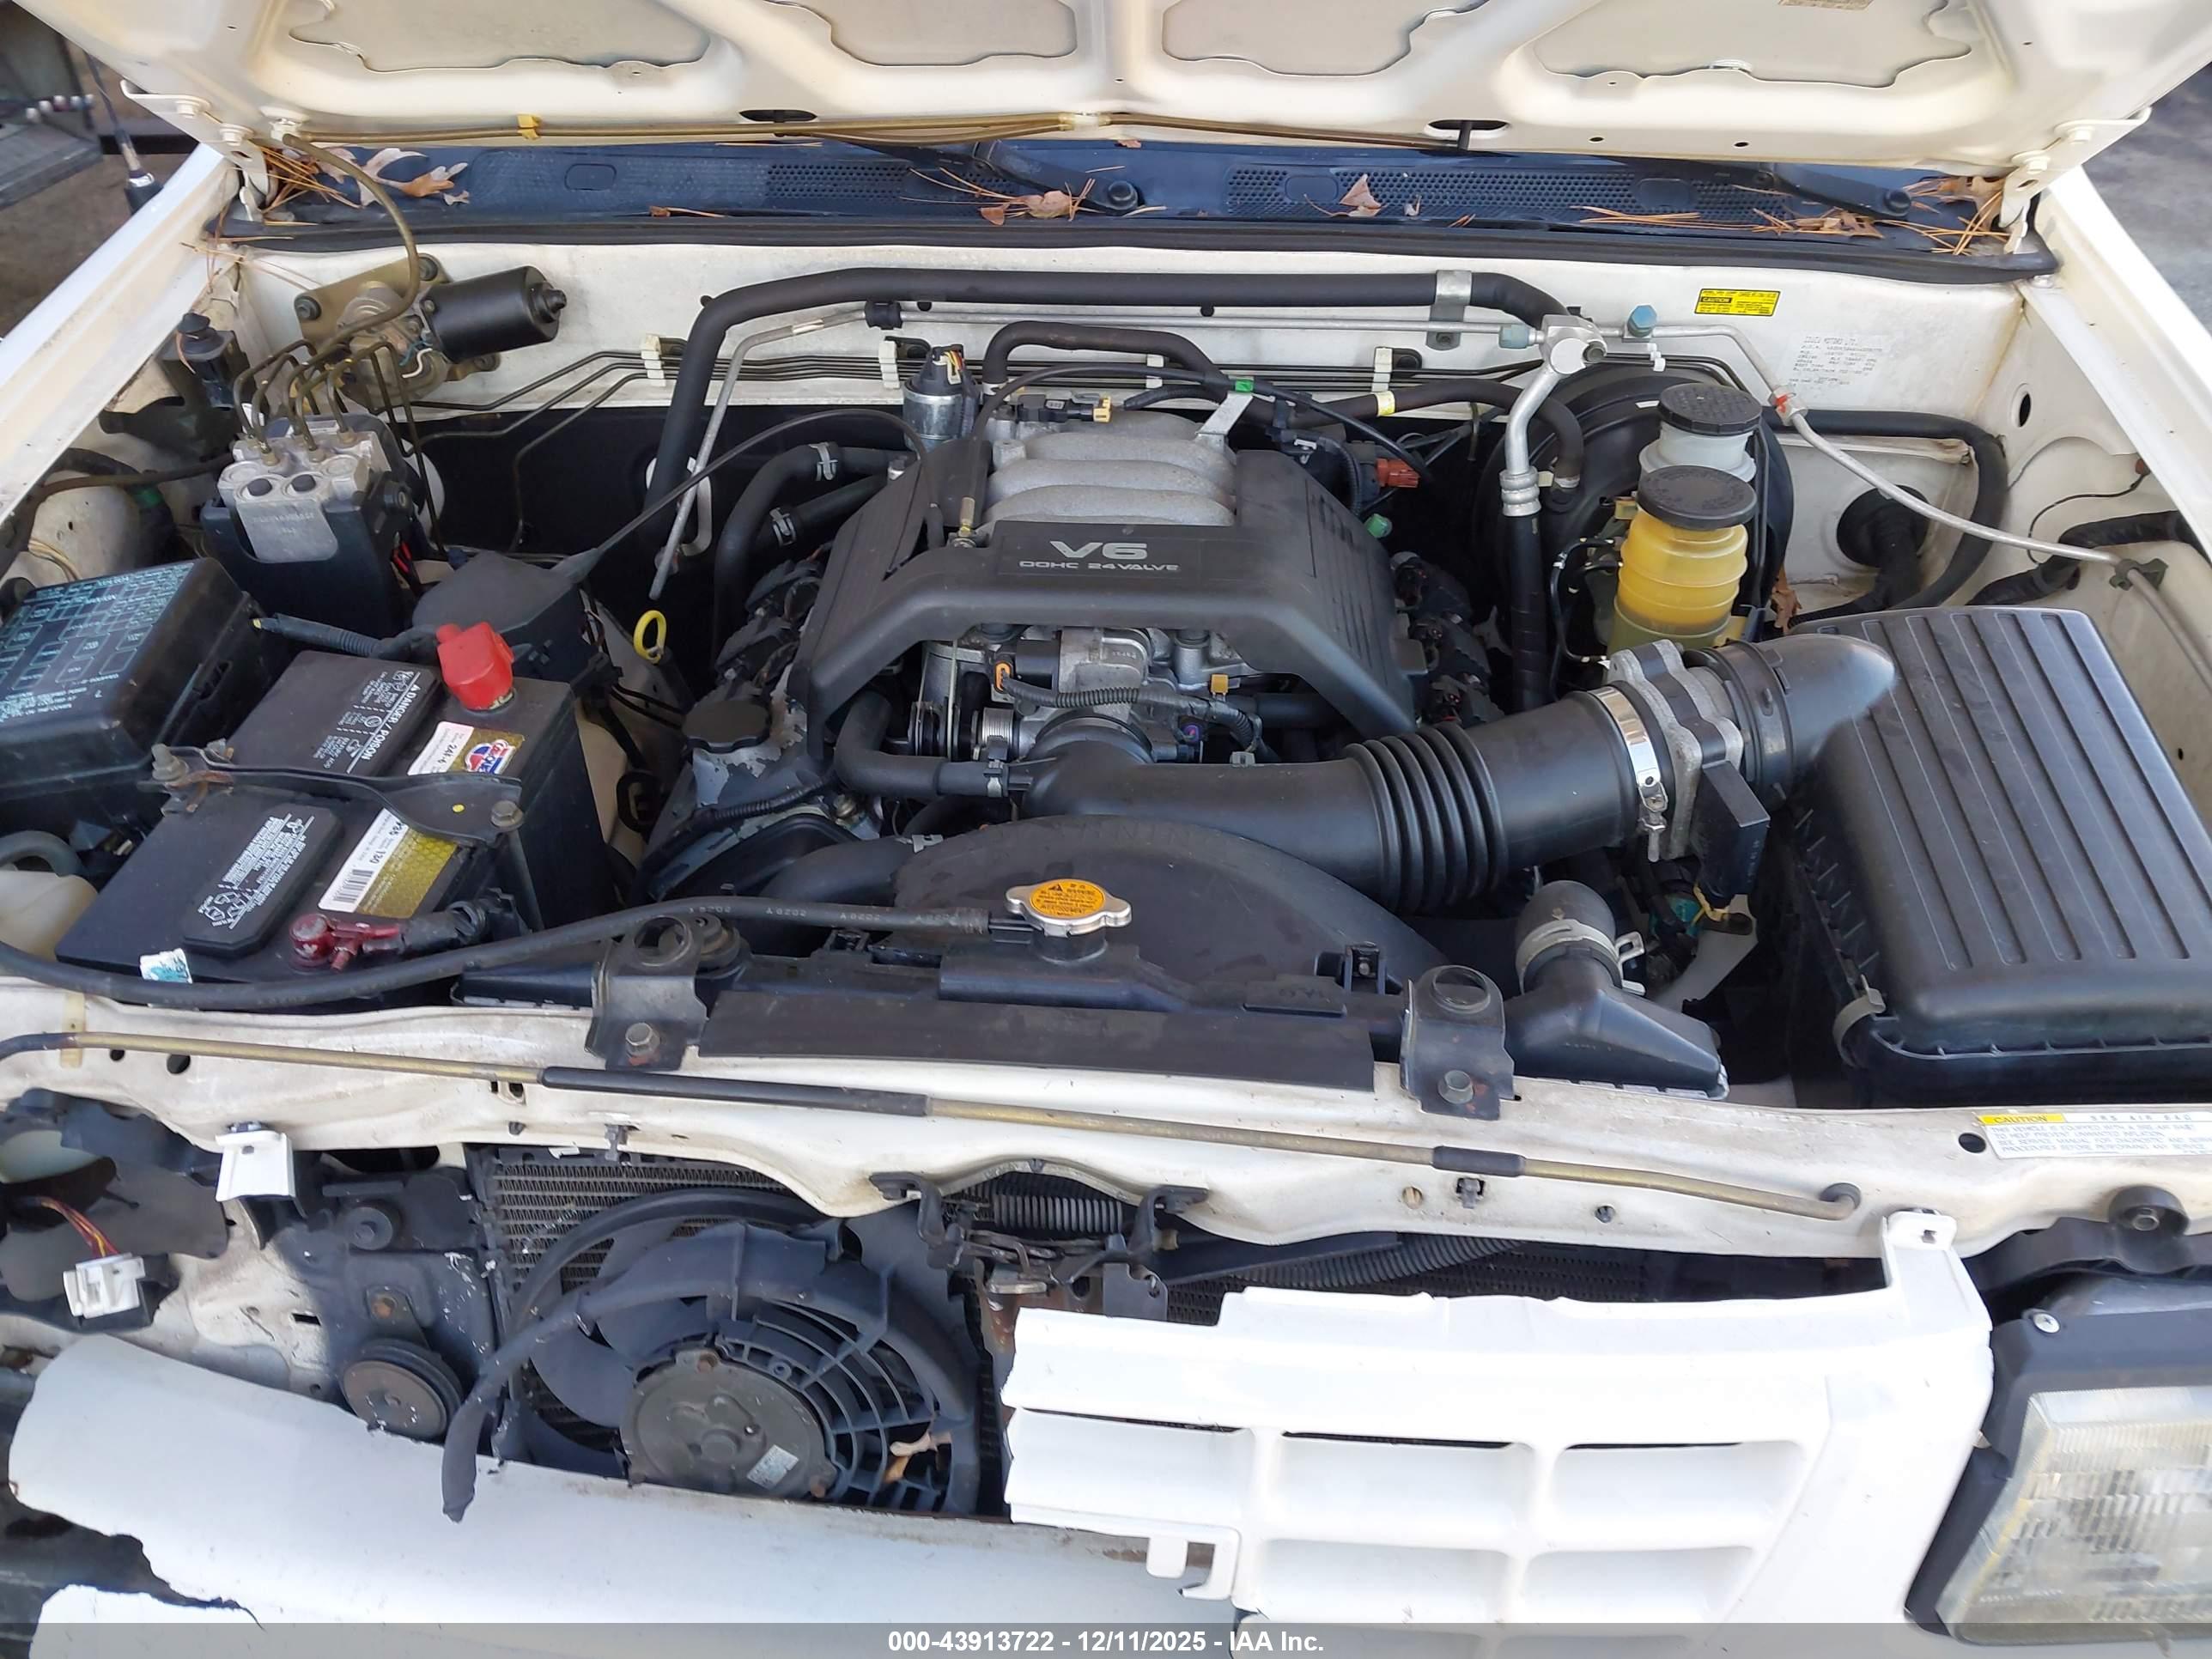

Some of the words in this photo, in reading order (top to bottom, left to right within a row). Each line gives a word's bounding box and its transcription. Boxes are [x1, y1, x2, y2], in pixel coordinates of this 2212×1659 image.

[1048, 540, 1148, 560] V6
[1018, 560, 1079, 569] DOHC
[389, 691, 417, 725] DANGER
[361, 728, 390, 761] POISON
[1993, 1115, 2049, 1125] CAUTION
